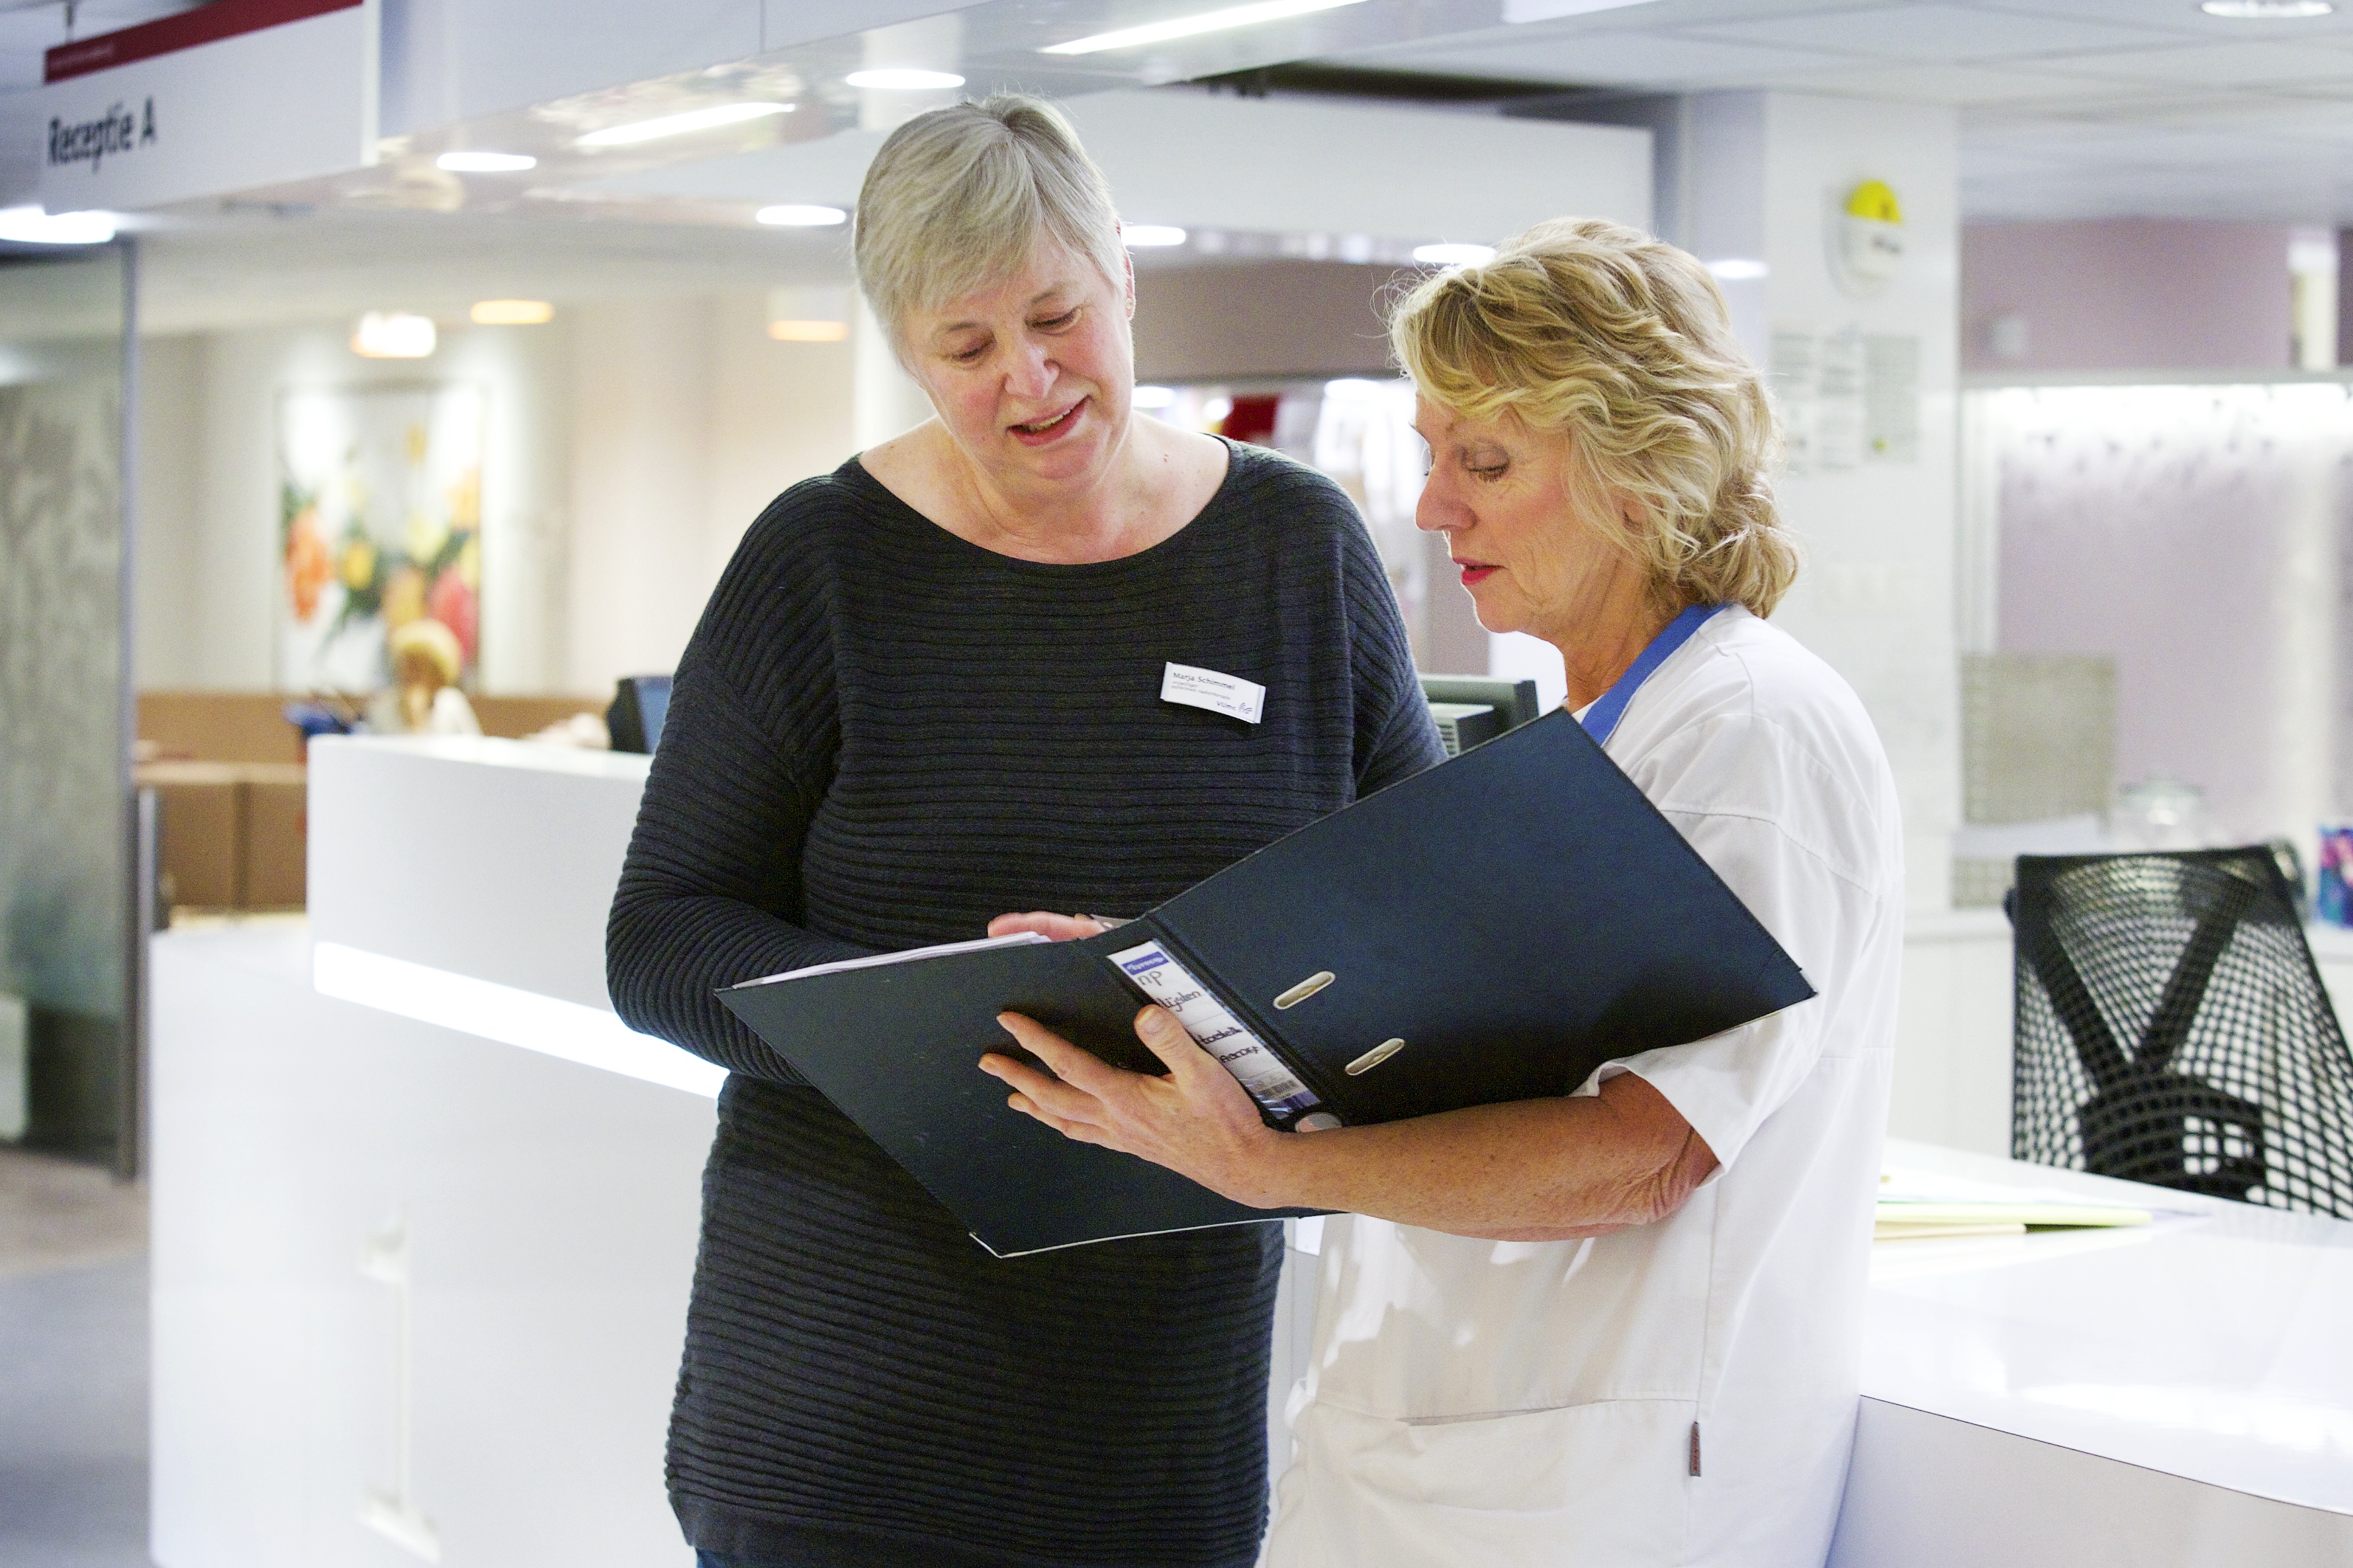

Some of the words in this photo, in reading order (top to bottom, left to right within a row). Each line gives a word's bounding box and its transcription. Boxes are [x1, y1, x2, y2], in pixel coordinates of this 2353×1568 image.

[47, 99, 134, 175] Receptie
[139, 94, 158, 147] A
[1173, 672, 1195, 682] Marja
[1198, 676, 1235, 691] Schimmel
